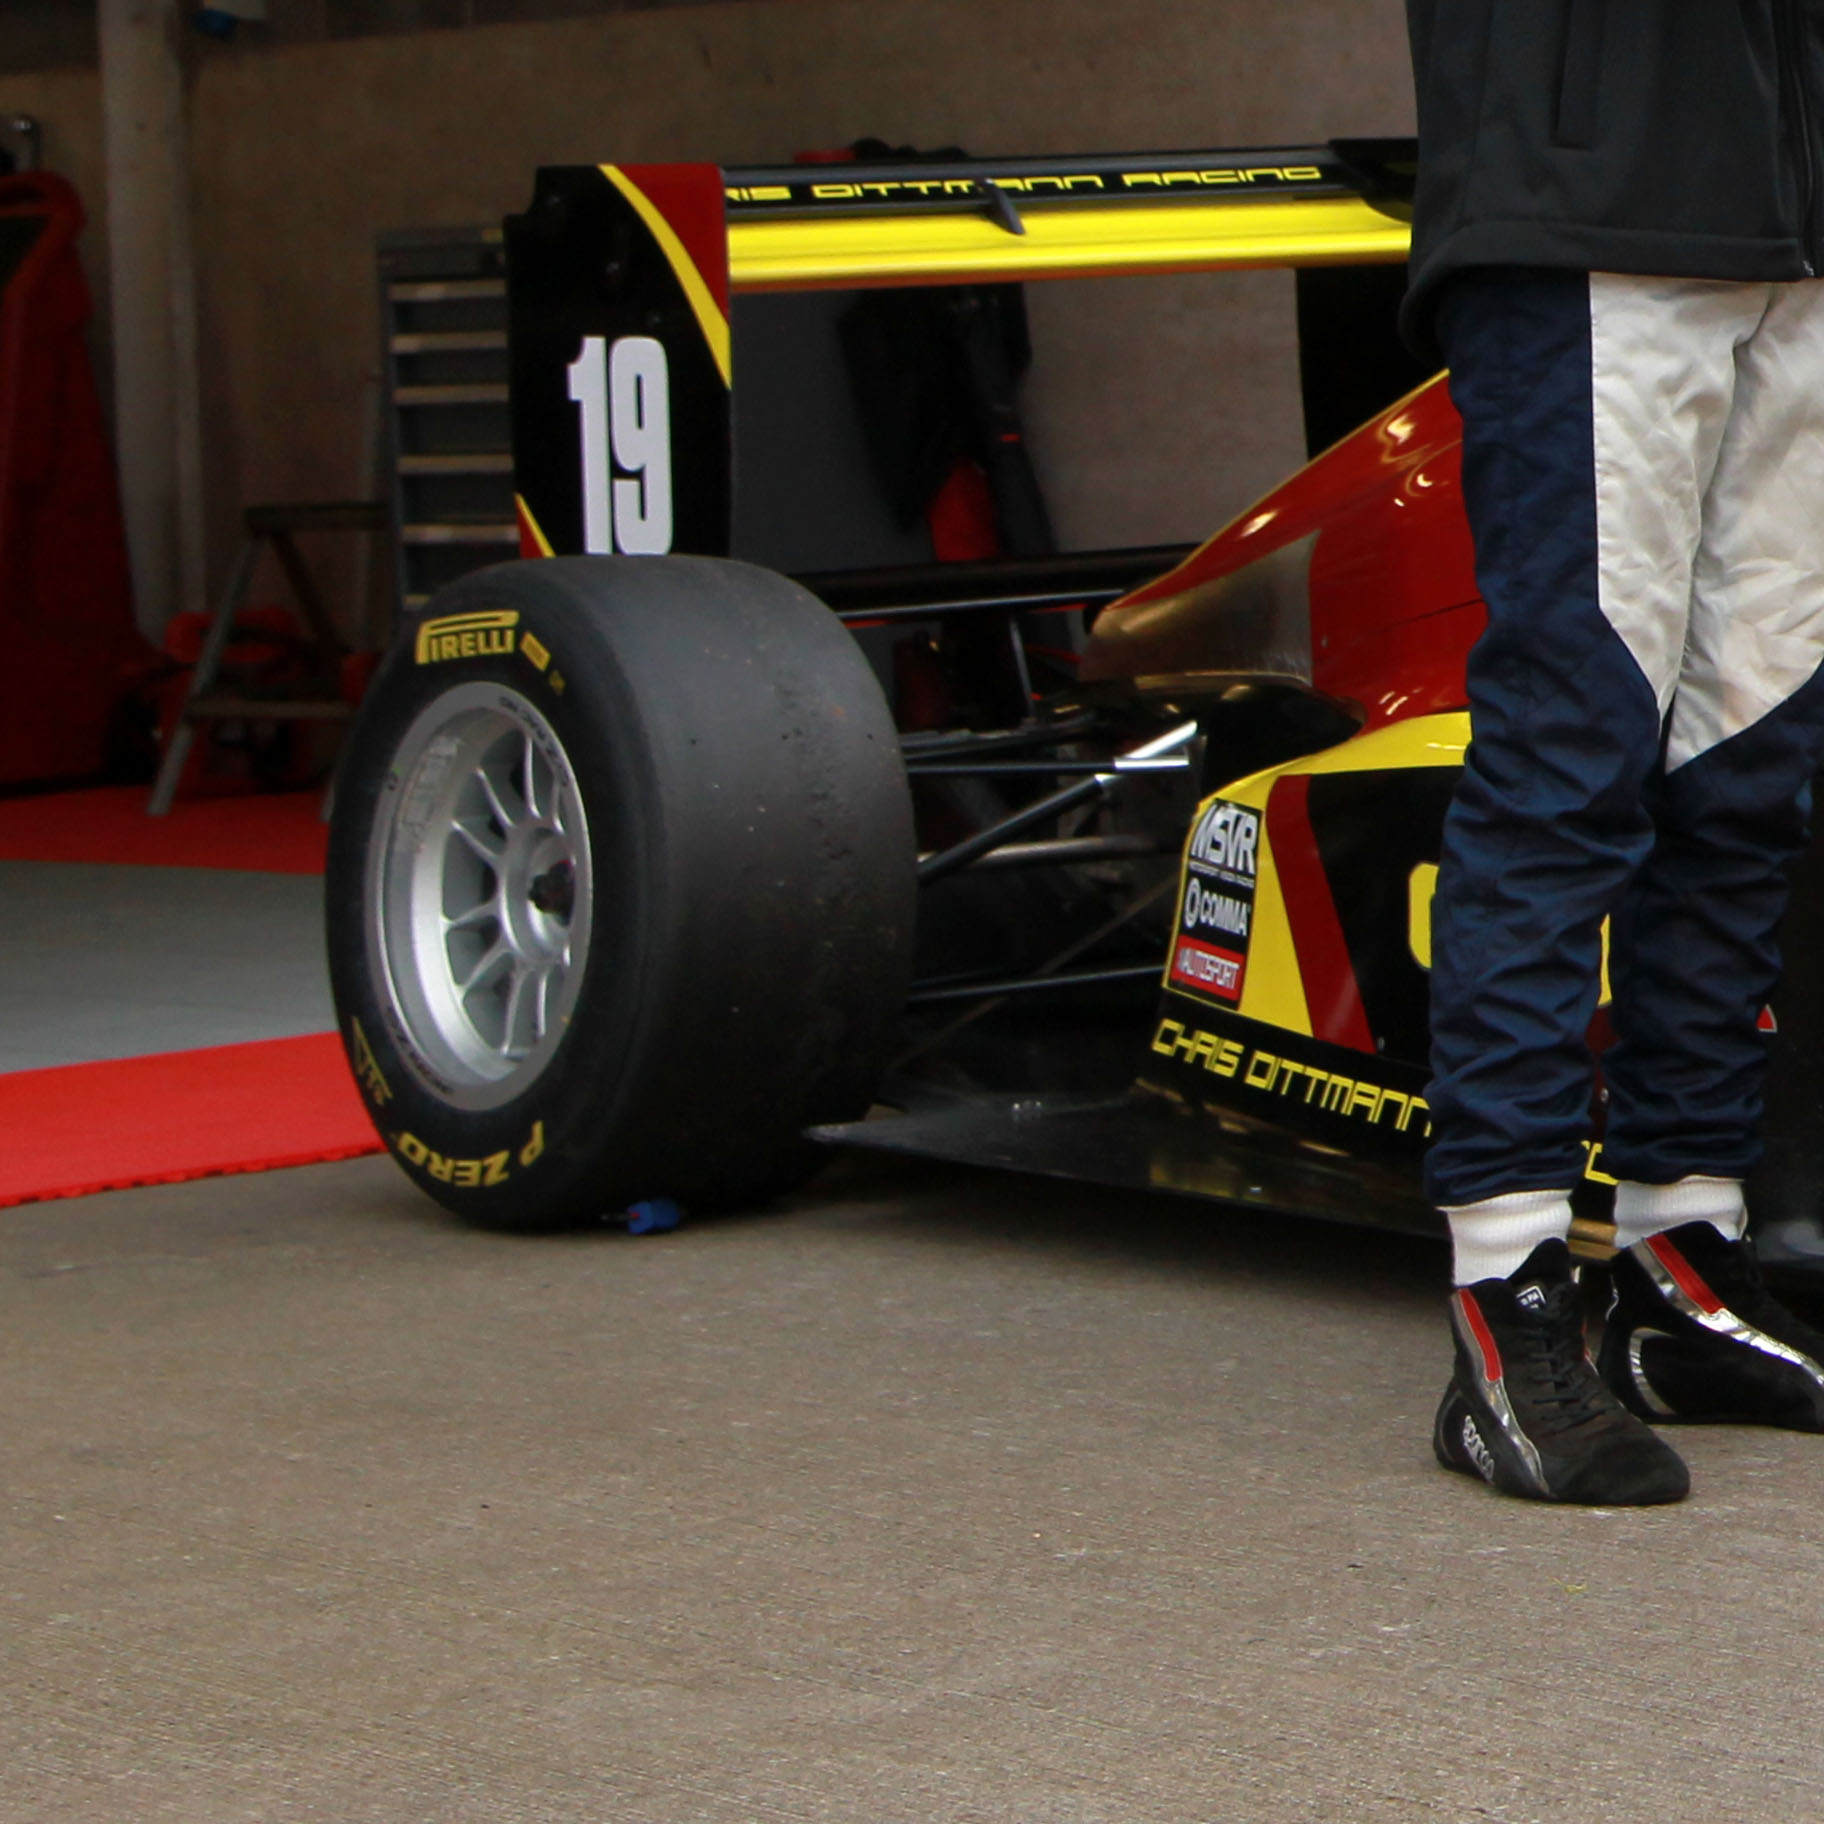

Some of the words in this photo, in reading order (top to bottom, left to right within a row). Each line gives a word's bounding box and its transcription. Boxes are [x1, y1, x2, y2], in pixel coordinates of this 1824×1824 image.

[1122, 166, 1322, 188] RACING
[567, 336, 673, 556] 19
[414, 609, 520, 665] PIRELLI
